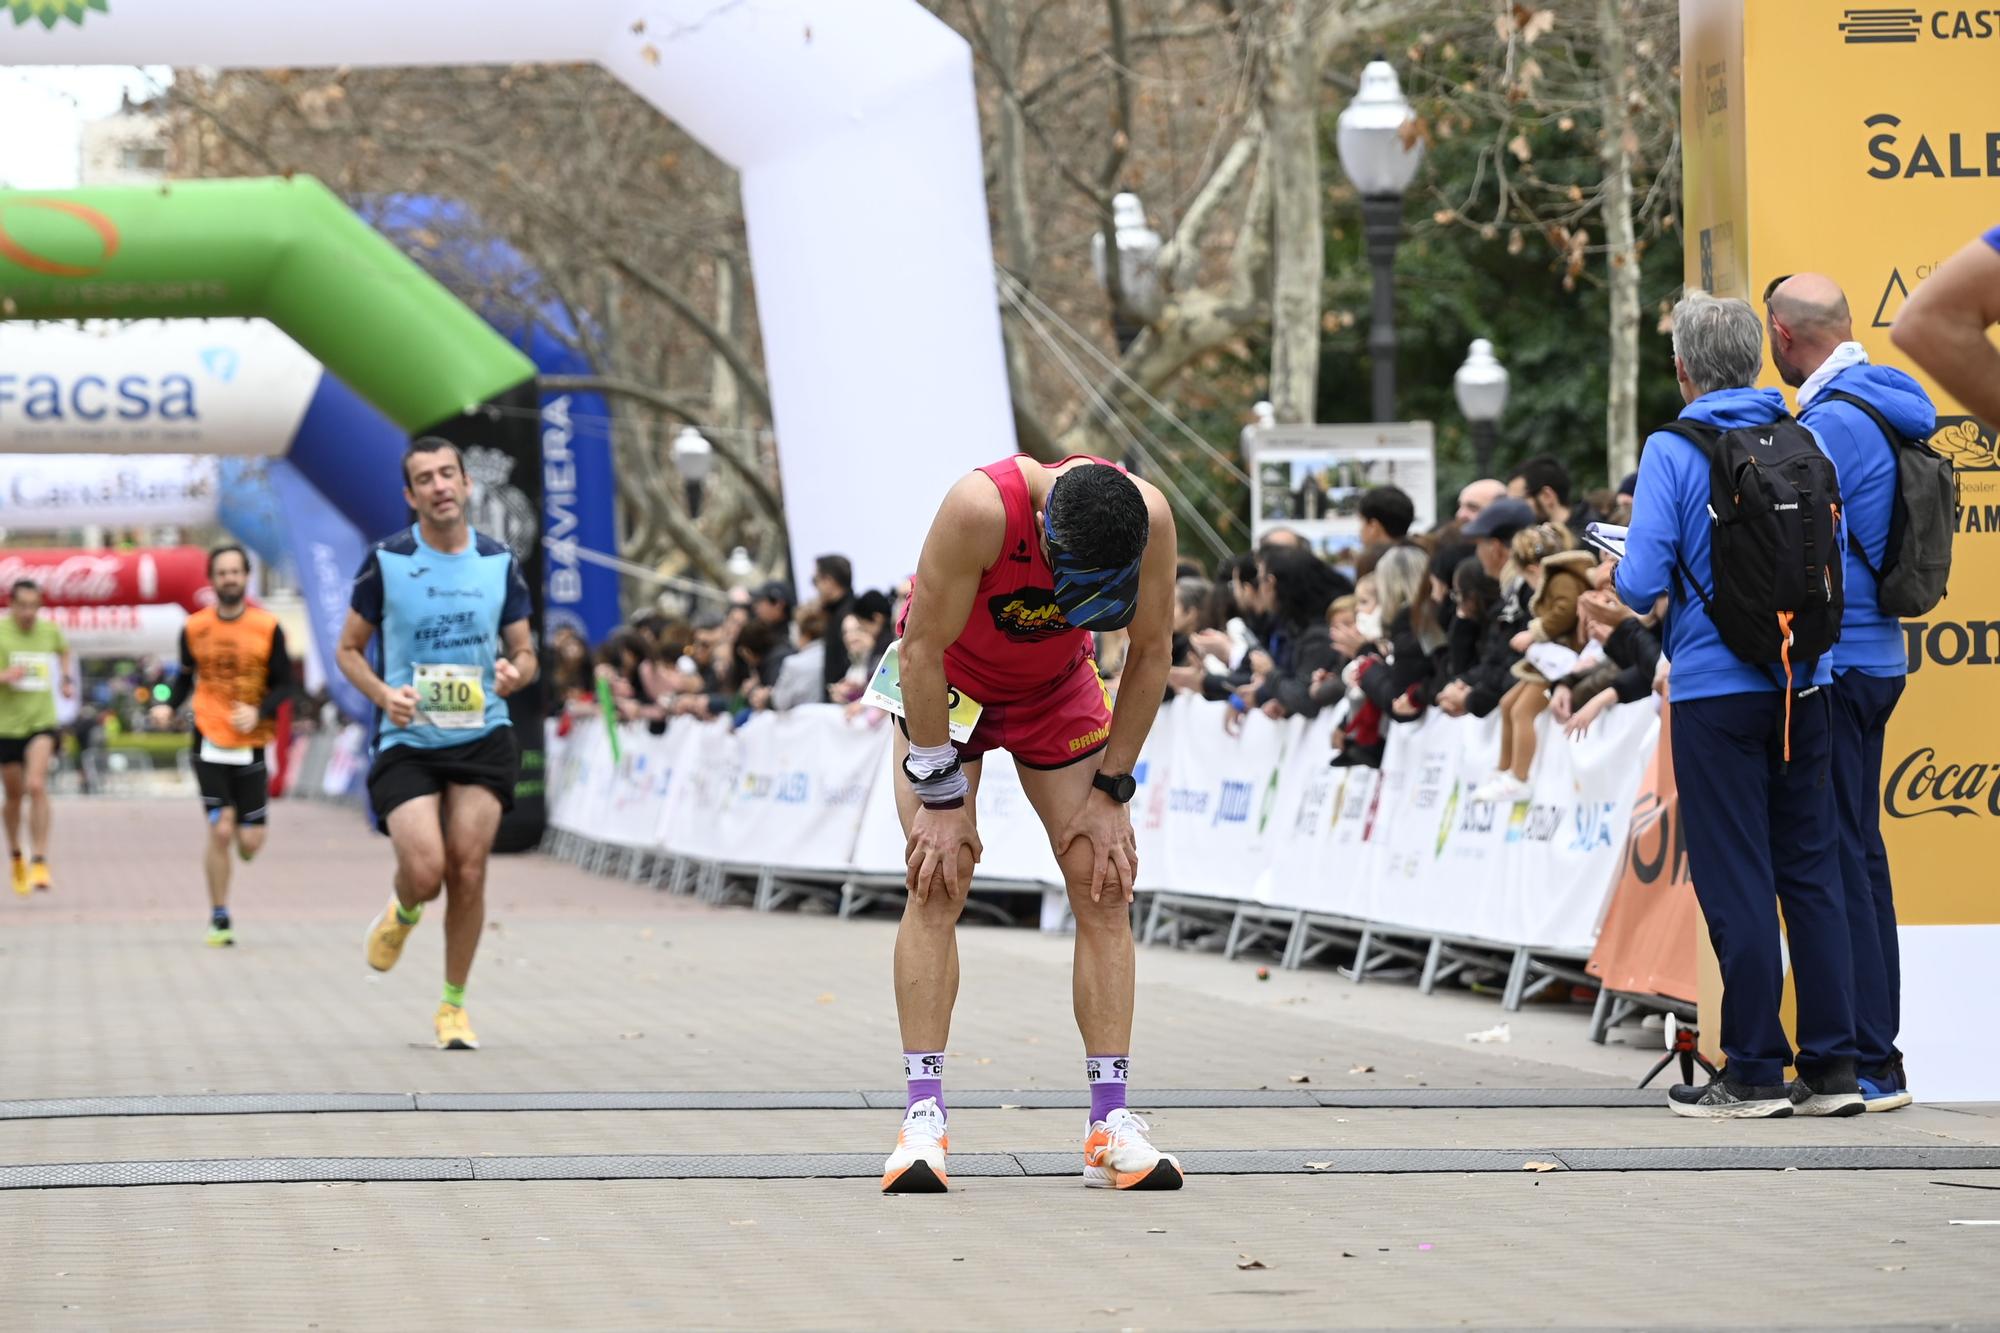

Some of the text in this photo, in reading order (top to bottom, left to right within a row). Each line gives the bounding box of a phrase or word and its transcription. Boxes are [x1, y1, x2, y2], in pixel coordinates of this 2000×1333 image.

[1864, 114, 2000, 179] SALE
[541, 394, 583, 604] BAVIERA
[430, 682, 470, 702] 310
